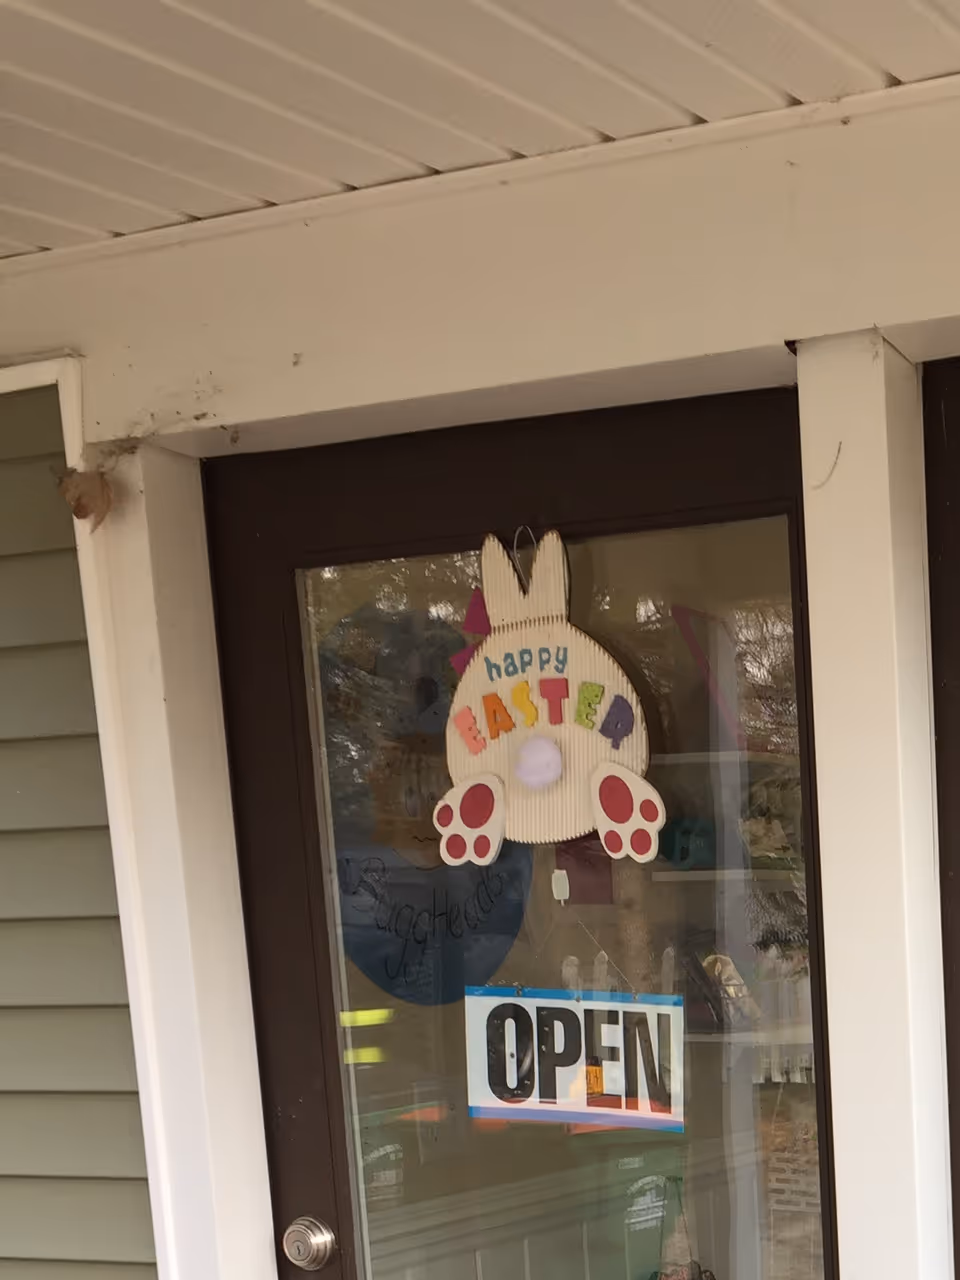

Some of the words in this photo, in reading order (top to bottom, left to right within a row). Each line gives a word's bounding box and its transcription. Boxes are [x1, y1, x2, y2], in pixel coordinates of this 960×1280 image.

[484, 645, 568, 682] happy
[453, 677, 635, 757] EASTER
[485, 1002, 673, 1114] OPEN
